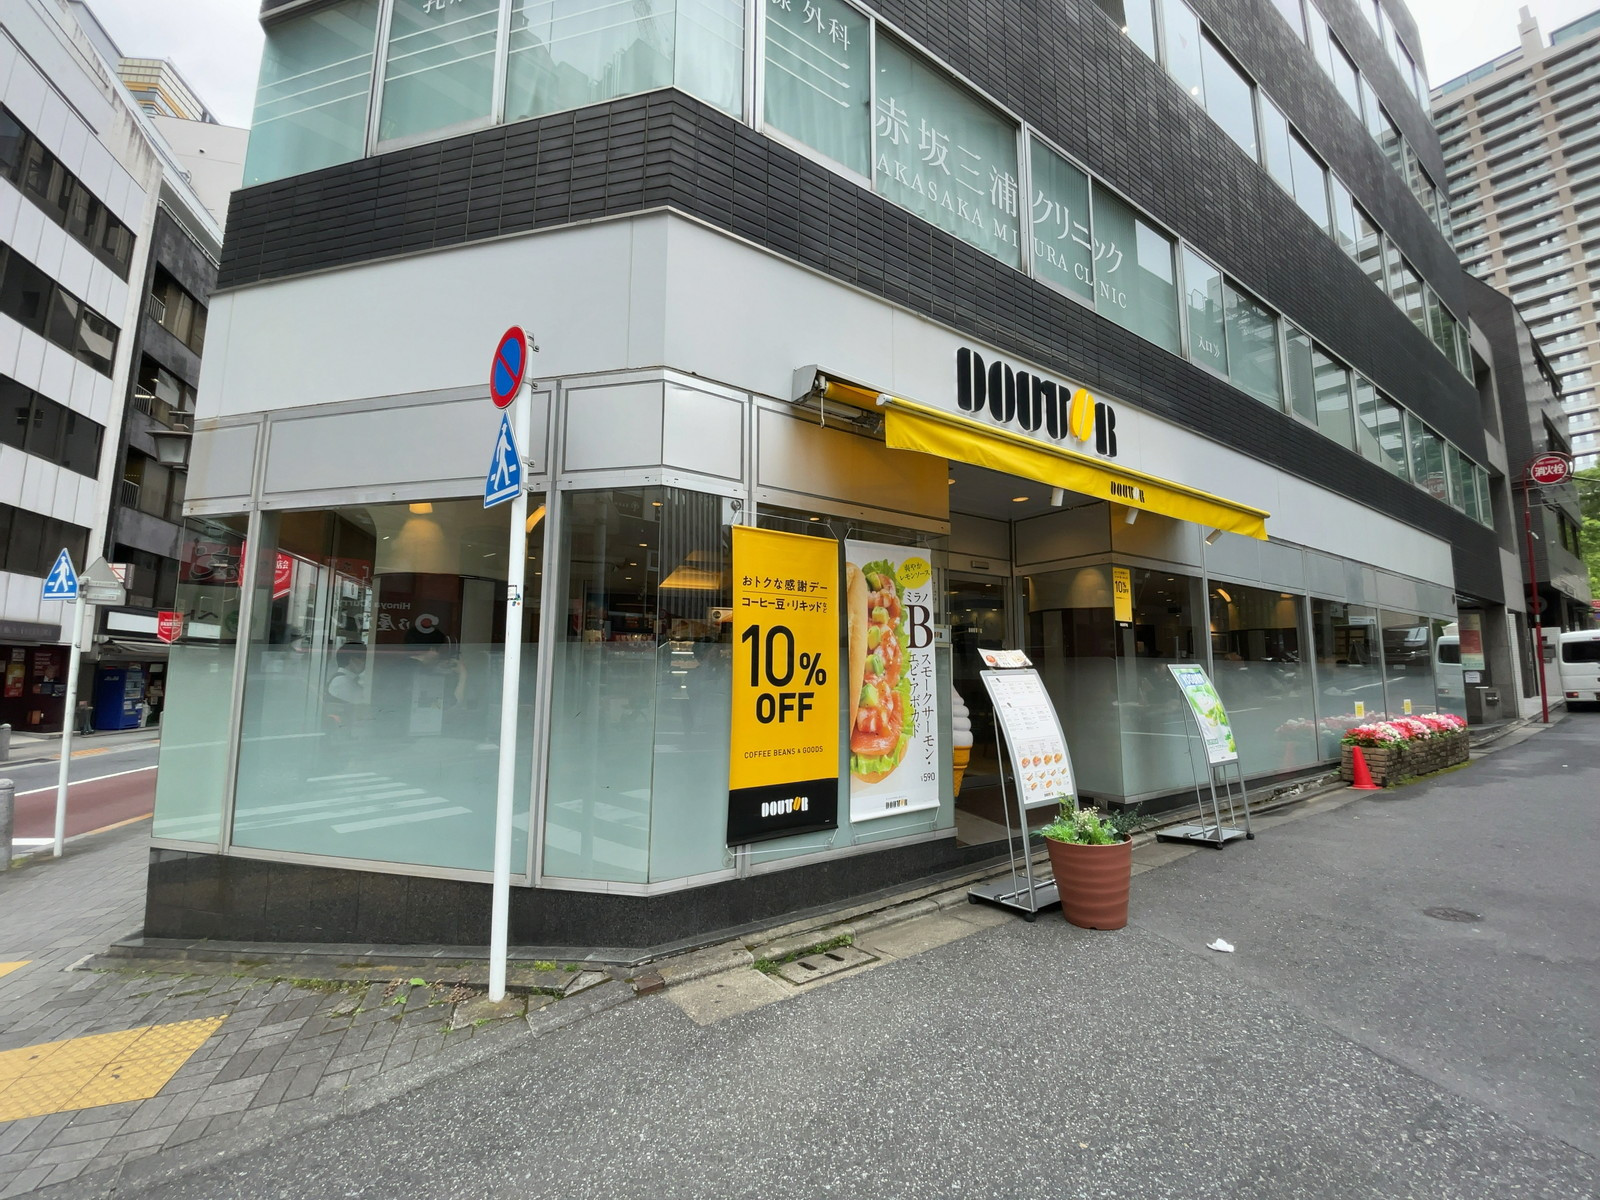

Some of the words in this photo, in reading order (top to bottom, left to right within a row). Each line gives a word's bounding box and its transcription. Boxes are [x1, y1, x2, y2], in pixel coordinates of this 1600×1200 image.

[875, 97, 1123, 273] 赤坂三浦クリニック
[876, 153, 985, 228] AKASAKA
[993, 217, 1069, 272] MIURA
[1074, 262, 1128, 310] CLNIC
[956, 346, 1118, 458] DOUTOR
[1534, 463, 1565, 477] 消火栓
[1110, 480, 1146, 504] DOUTOR
[742, 575, 828, 593] おトクな感謝デー
[899, 569, 931, 581] レモンソース
[906, 591, 928, 603] ミラノ
[904, 604, 934, 649] B
[741, 624, 827, 688] 10%
[756, 692, 815, 724] OFF
[908, 653, 921, 739] エビ・アボカド
[744, 751, 772, 759] COFFEE
[773, 747, 796, 757] BEANS
[802, 745, 824, 754] GOODS
[761, 796, 809, 818] DOUTOR
